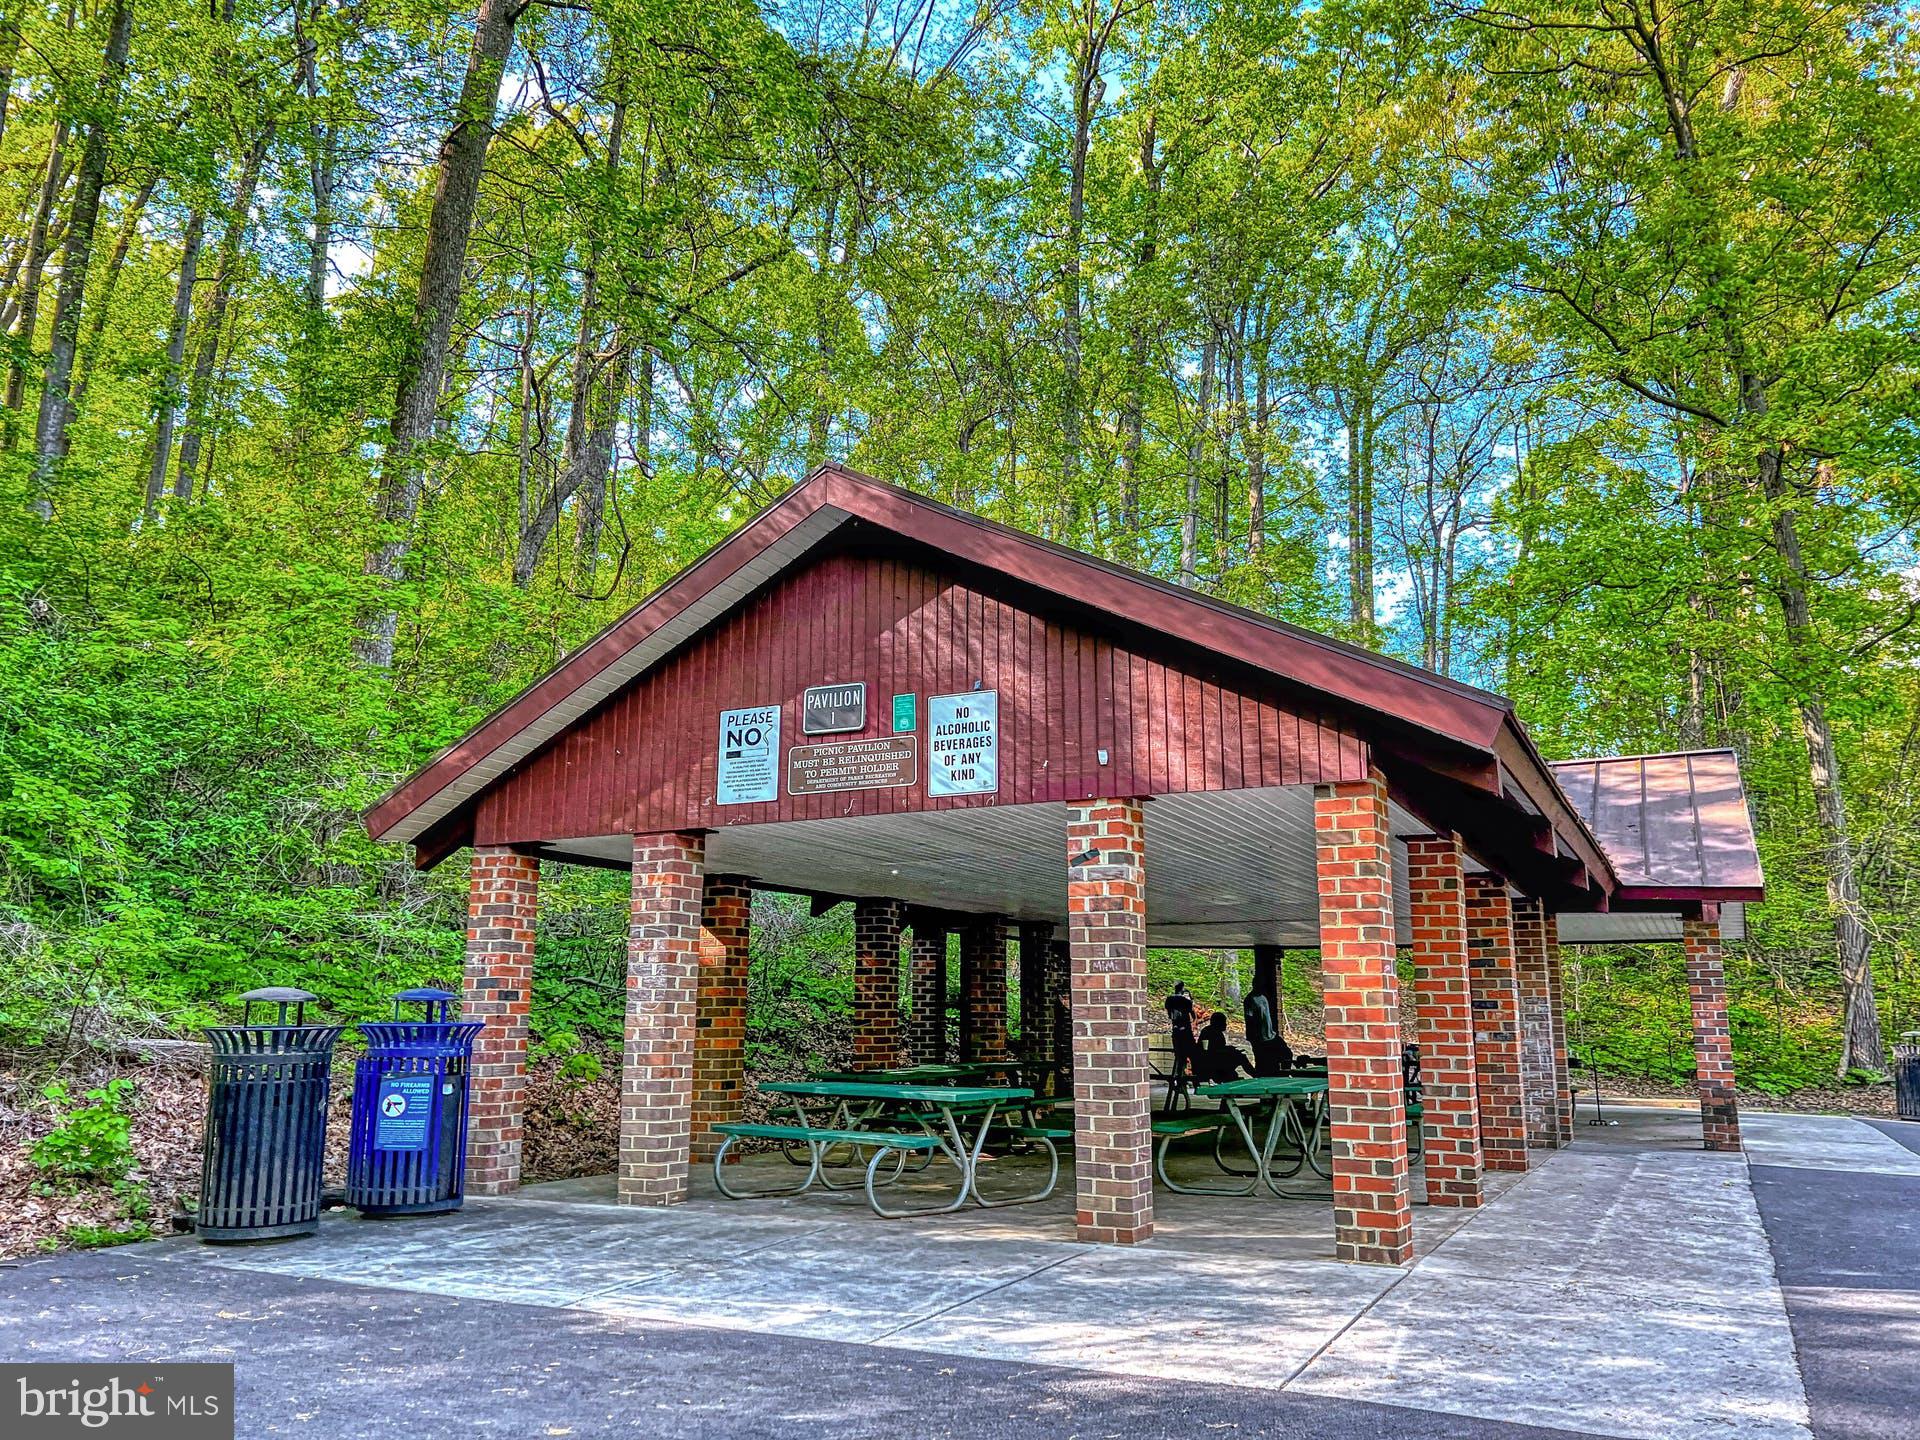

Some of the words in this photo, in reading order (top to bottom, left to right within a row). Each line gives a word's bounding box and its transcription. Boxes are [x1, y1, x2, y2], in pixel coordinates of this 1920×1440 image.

[808, 690, 860, 710] PAVILION
[727, 711, 773, 727] PLEASE
[956, 707, 969, 719] NO
[936, 720, 990, 736] ALCOHOLIC
[727, 728, 761, 748] NO
[934, 735, 991, 751] BEVERAGES
[813, 746, 844, 757] PICNIC
[847, 741, 891, 753] PAVILION
[793, 759, 819, 769] MUST
[822, 757, 835, 766] BE
[838, 750, 912, 765] RELINQUISHED
[944, 755, 956, 766] OF
[961, 752, 981, 765] ANY
[805, 770, 817, 779] TO
[820, 766, 857, 777] PERMIT
[860, 762, 900, 774] HOLDER
[951, 768, 975, 781] KIND
[807, 776, 839, 785] DEPARTMENT
[827, 780, 857, 788] COMMUNITY
